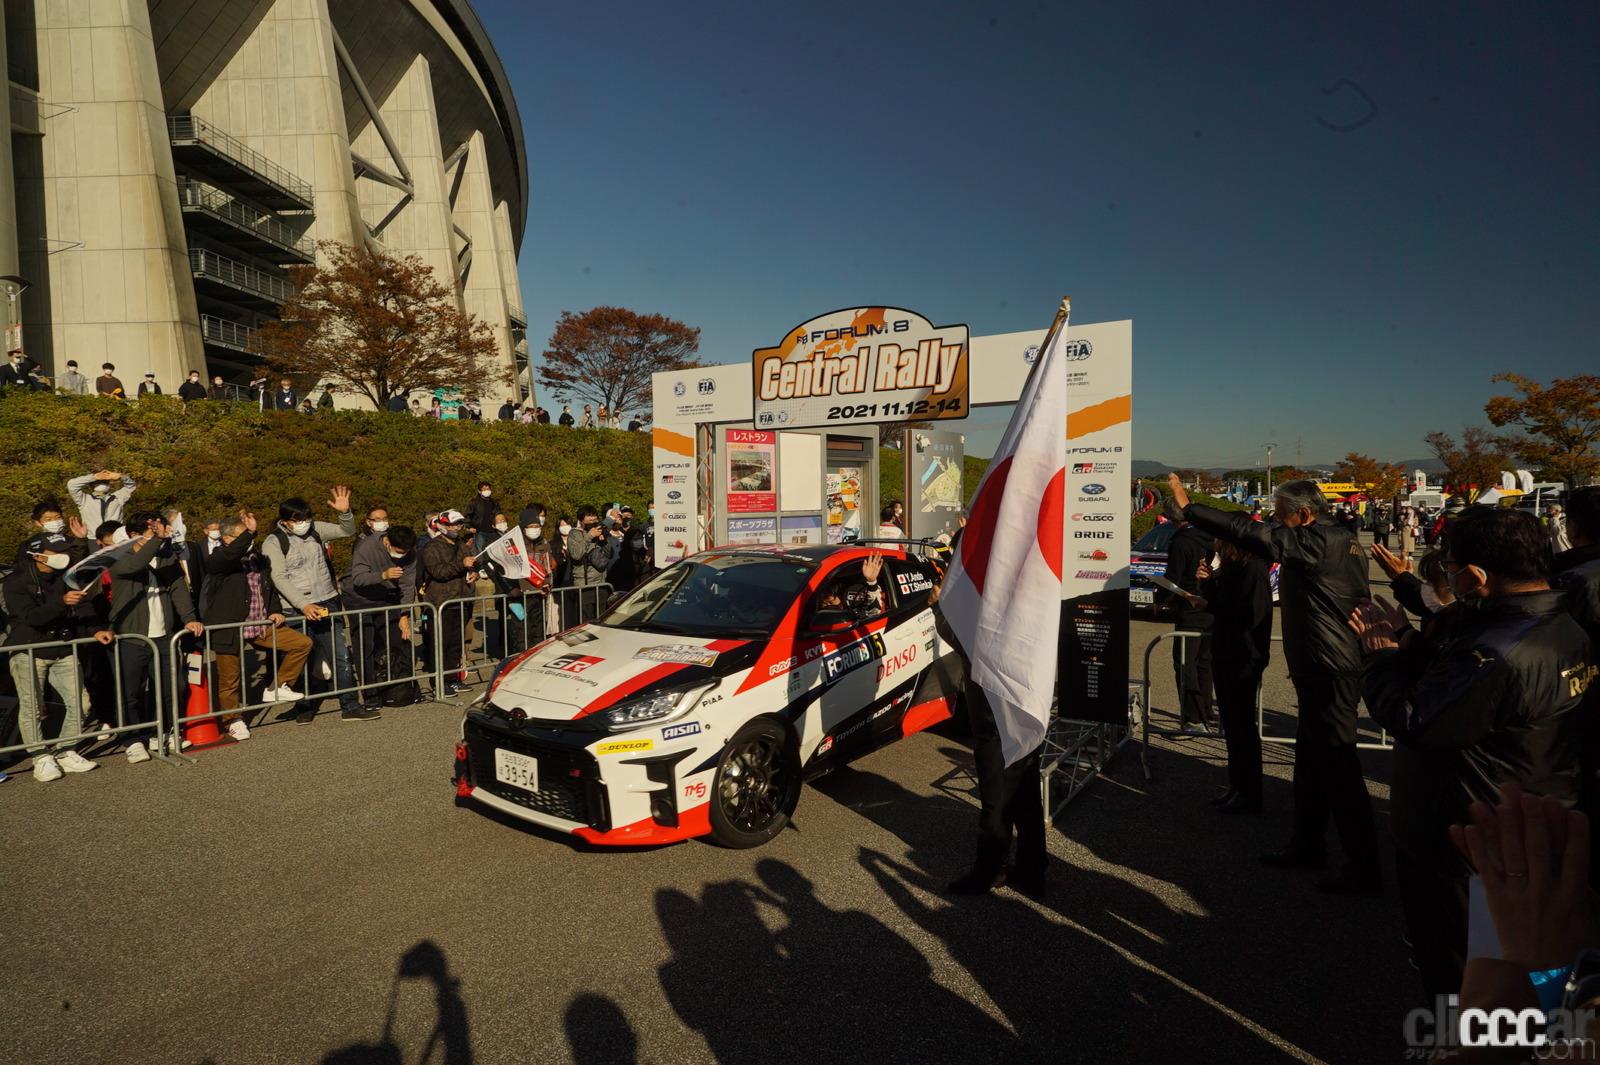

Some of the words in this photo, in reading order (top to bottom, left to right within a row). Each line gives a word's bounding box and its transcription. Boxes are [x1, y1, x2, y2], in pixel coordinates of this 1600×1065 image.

[811, 322, 888, 342] FORUM
[893, 319, 909, 332] 8
[759, 346, 871, 401] Central
[873, 338, 964, 394] Rally
[827, 404, 877, 420] 2021
[881, 398, 961, 416] 11.12-14
[733, 431, 768, 442] レストラン
[1071, 447, 1110, 455] FORUM
[1074, 531, 1114, 539] BRIDE
[873, 635, 885, 656] 5
[545, 657, 590, 674] GR
[769, 655, 798, 676] RAYS
[876, 644, 917, 683] DENSO
[702, 694, 723, 708] PIAA
[662, 723, 700, 739] AISIN
[608, 742, 649, 751] DUNLOP
[504, 764, 535, 788] 39-54
